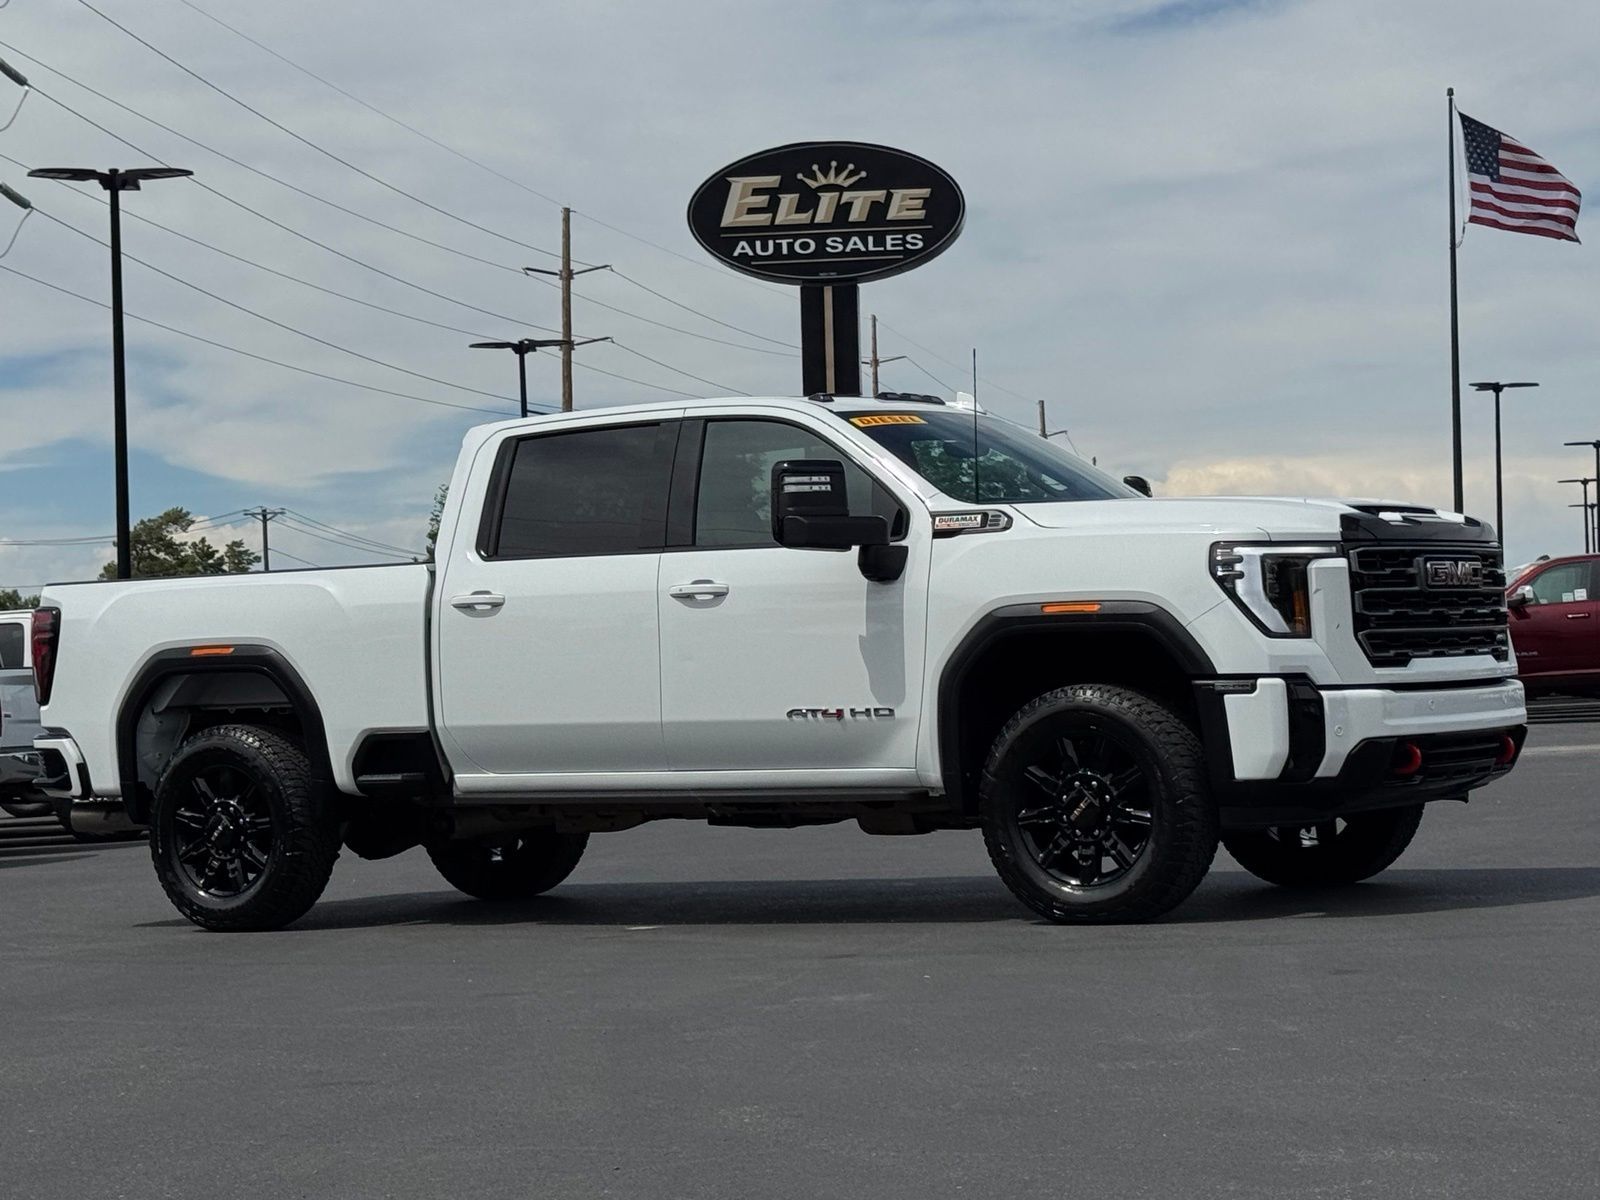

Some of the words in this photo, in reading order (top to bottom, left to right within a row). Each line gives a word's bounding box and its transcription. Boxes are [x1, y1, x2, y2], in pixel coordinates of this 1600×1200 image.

[720, 175, 932, 228] ELITE
[733, 238, 816, 257] AUTO
[825, 233, 924, 252] SALES
[857, 416, 921, 425] DIESEL
[938, 516, 978, 524] DURAMAX
[1427, 561, 1483, 585] GMC
[786, 708, 844, 721] AT4
[849, 708, 896, 718] HD
